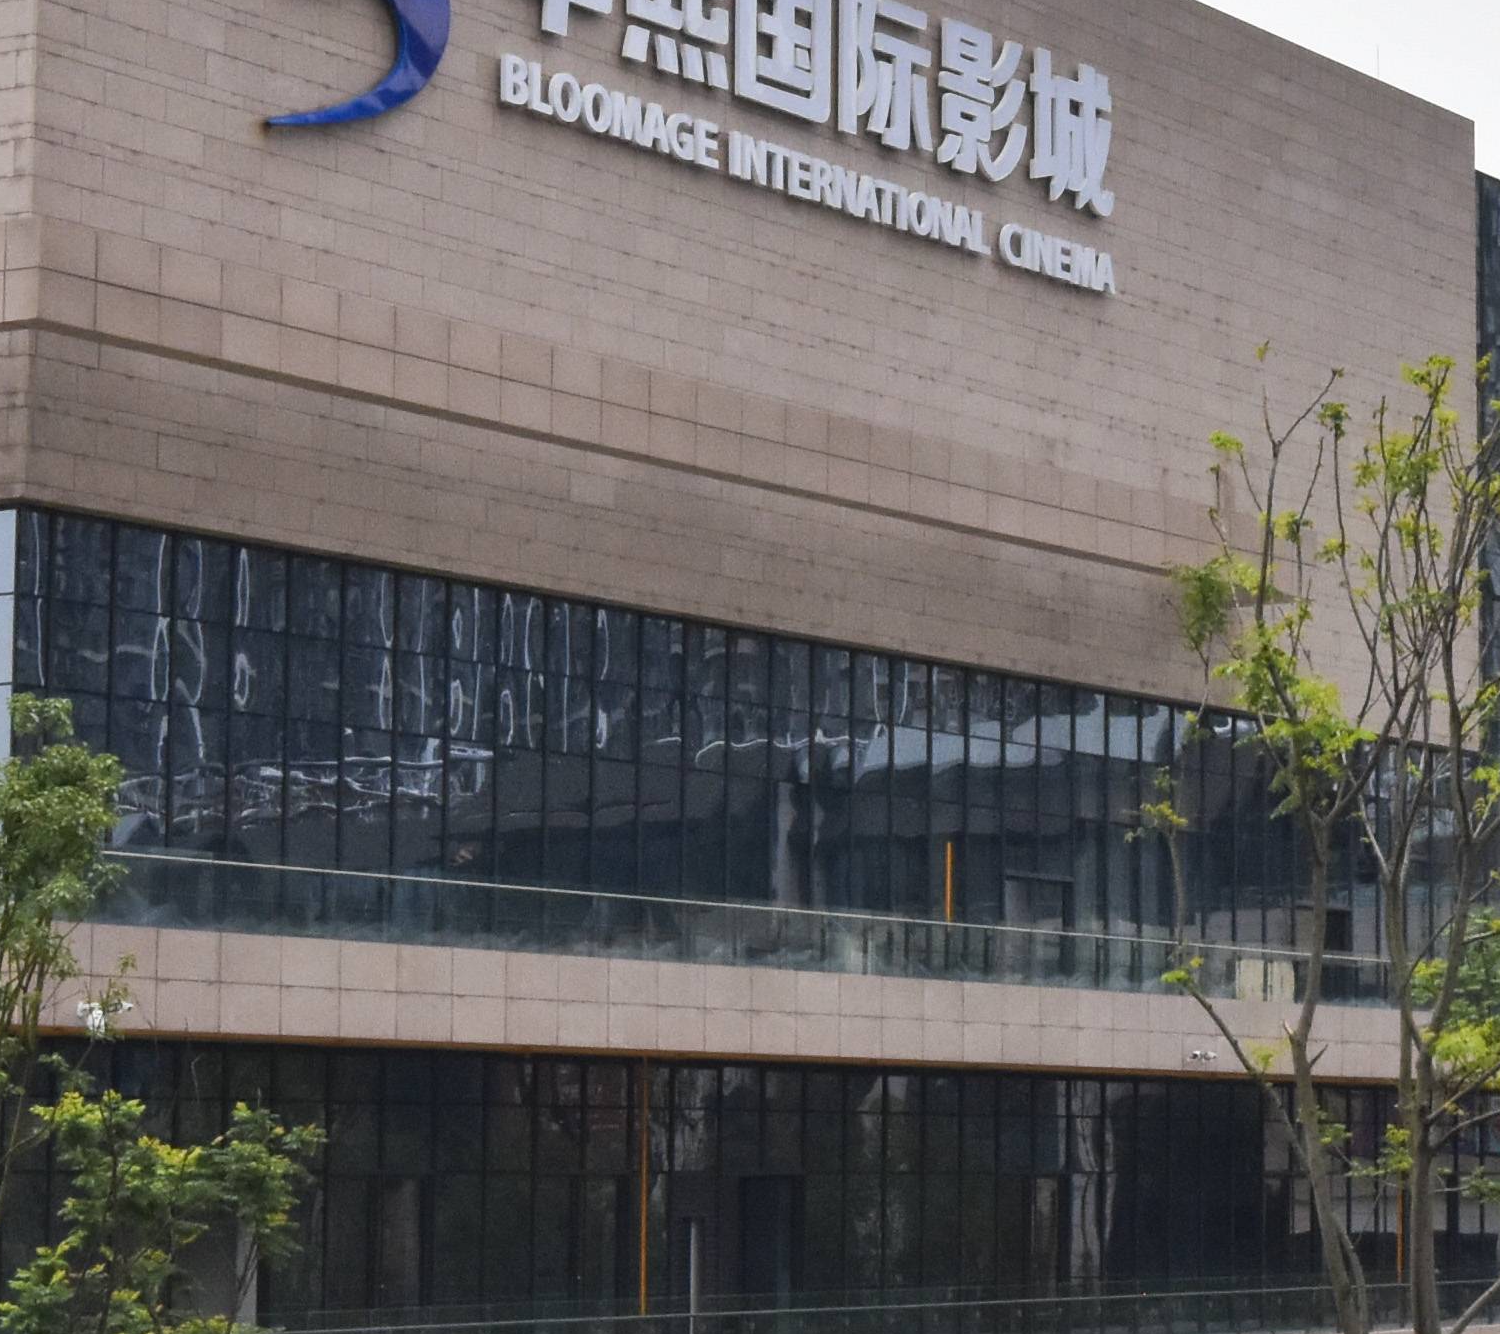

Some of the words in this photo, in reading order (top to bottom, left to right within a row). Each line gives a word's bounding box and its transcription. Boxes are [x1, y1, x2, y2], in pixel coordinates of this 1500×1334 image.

[500, 53, 720, 170] BLOOMAGE
[728, 132, 992, 256] INTERNATIONAL
[999, 223, 1115, 295] CINEMA
